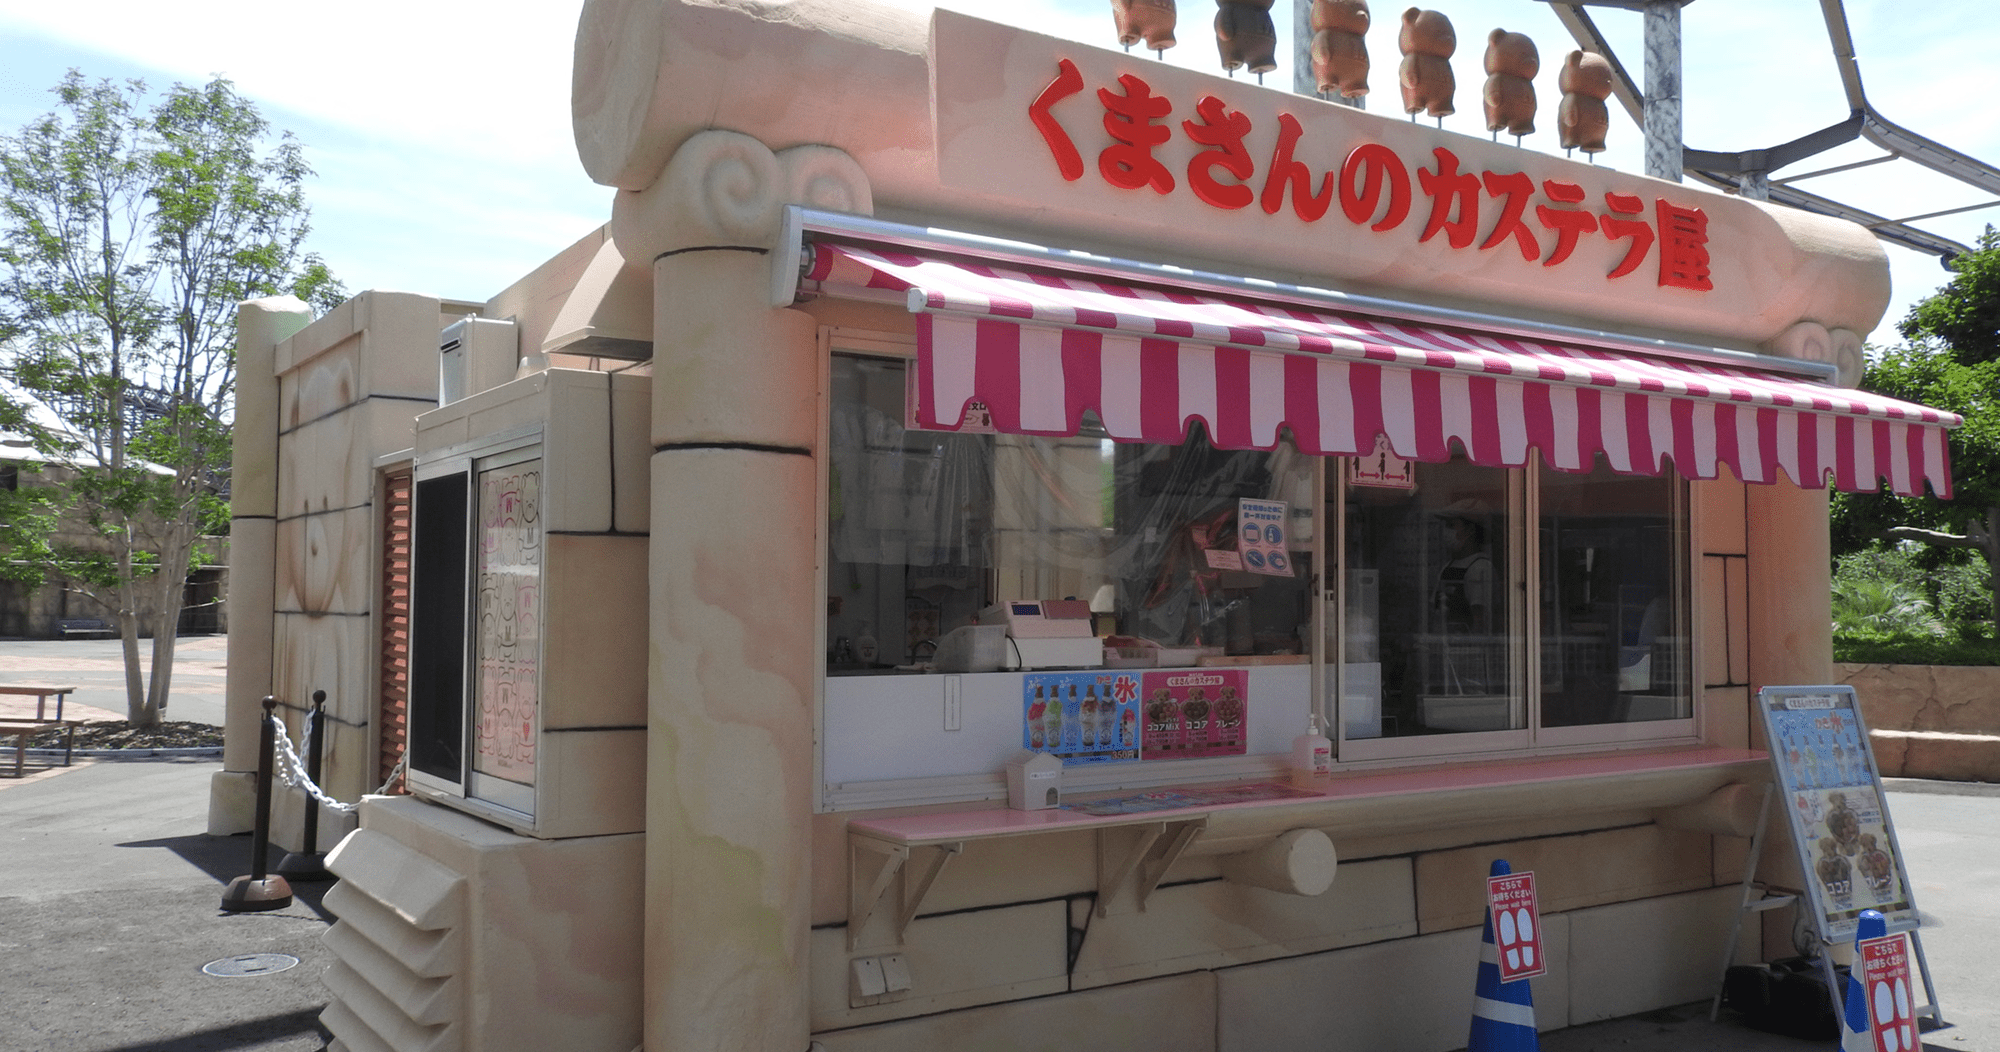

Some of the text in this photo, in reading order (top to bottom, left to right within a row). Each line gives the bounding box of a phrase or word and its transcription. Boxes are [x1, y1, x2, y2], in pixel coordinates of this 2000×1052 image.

[1028, 57, 1714, 292] くまさんのカステラ屋
[1185, 720, 1208, 729] ココア
[1500, 879, 1522, 891] こちらで
[1826, 881, 1850, 894] ココア
[1493, 889, 1532, 902] お待ちください
[1874, 943, 1898, 956] こちらで
